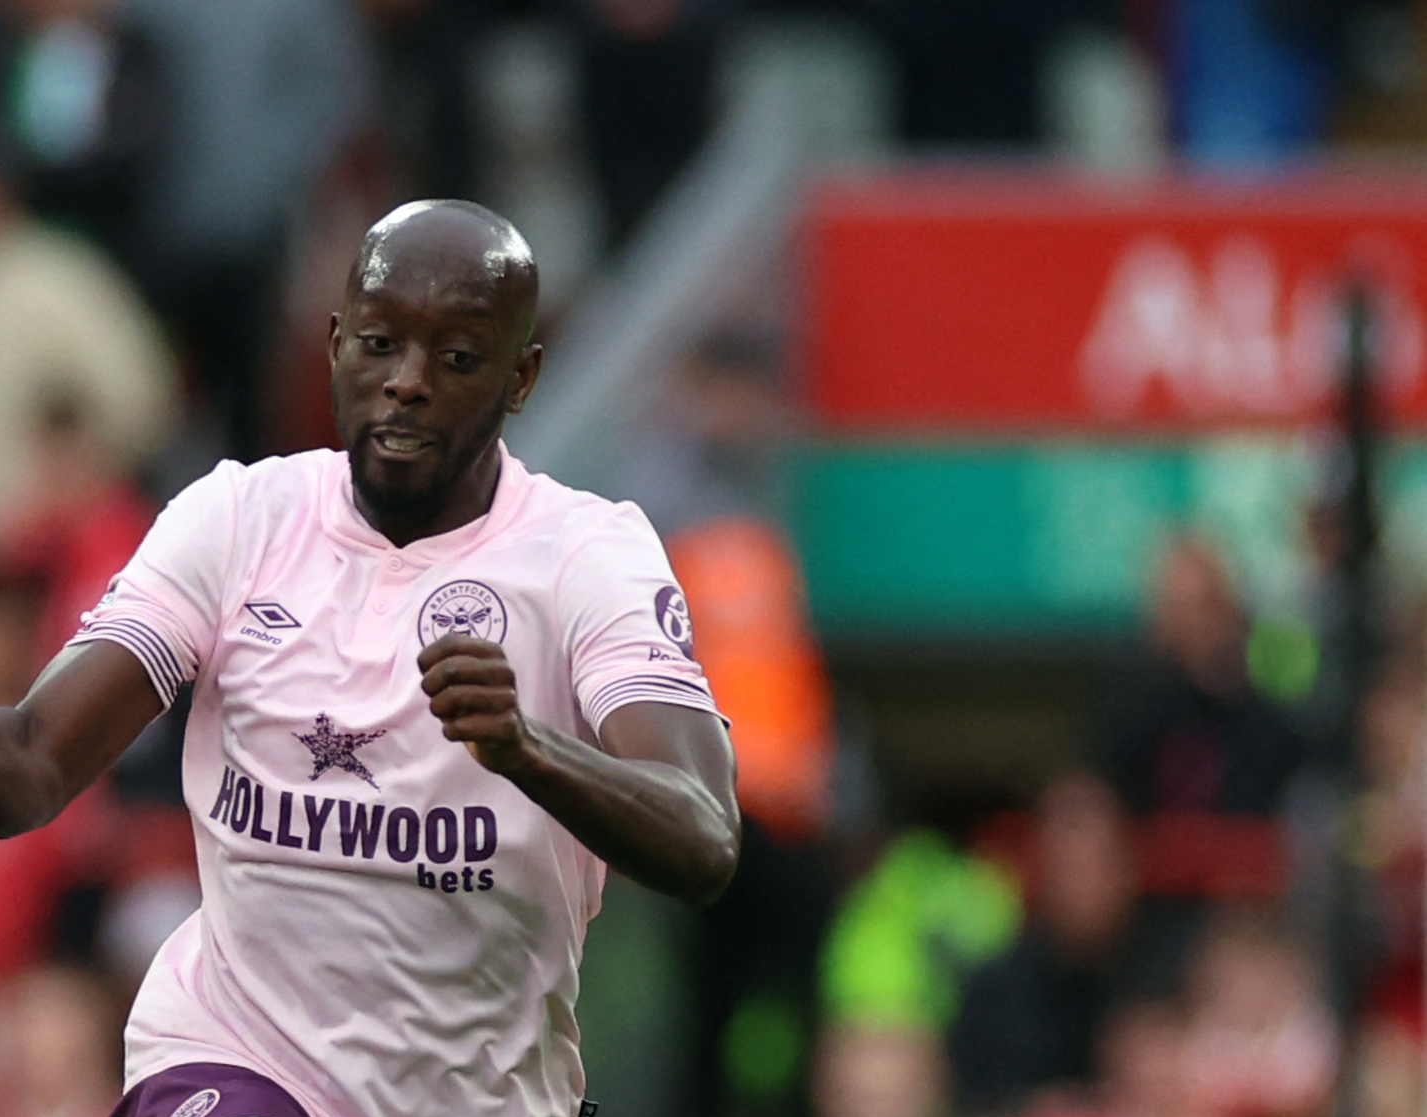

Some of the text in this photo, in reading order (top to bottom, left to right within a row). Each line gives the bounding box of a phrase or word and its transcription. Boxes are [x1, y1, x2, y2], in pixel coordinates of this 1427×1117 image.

[430, 585, 493, 610] BRENTFORD
[240, 626, 283, 645] umbro
[209, 764, 498, 865] HOLLYWOOD
[417, 863, 495, 894] bets
